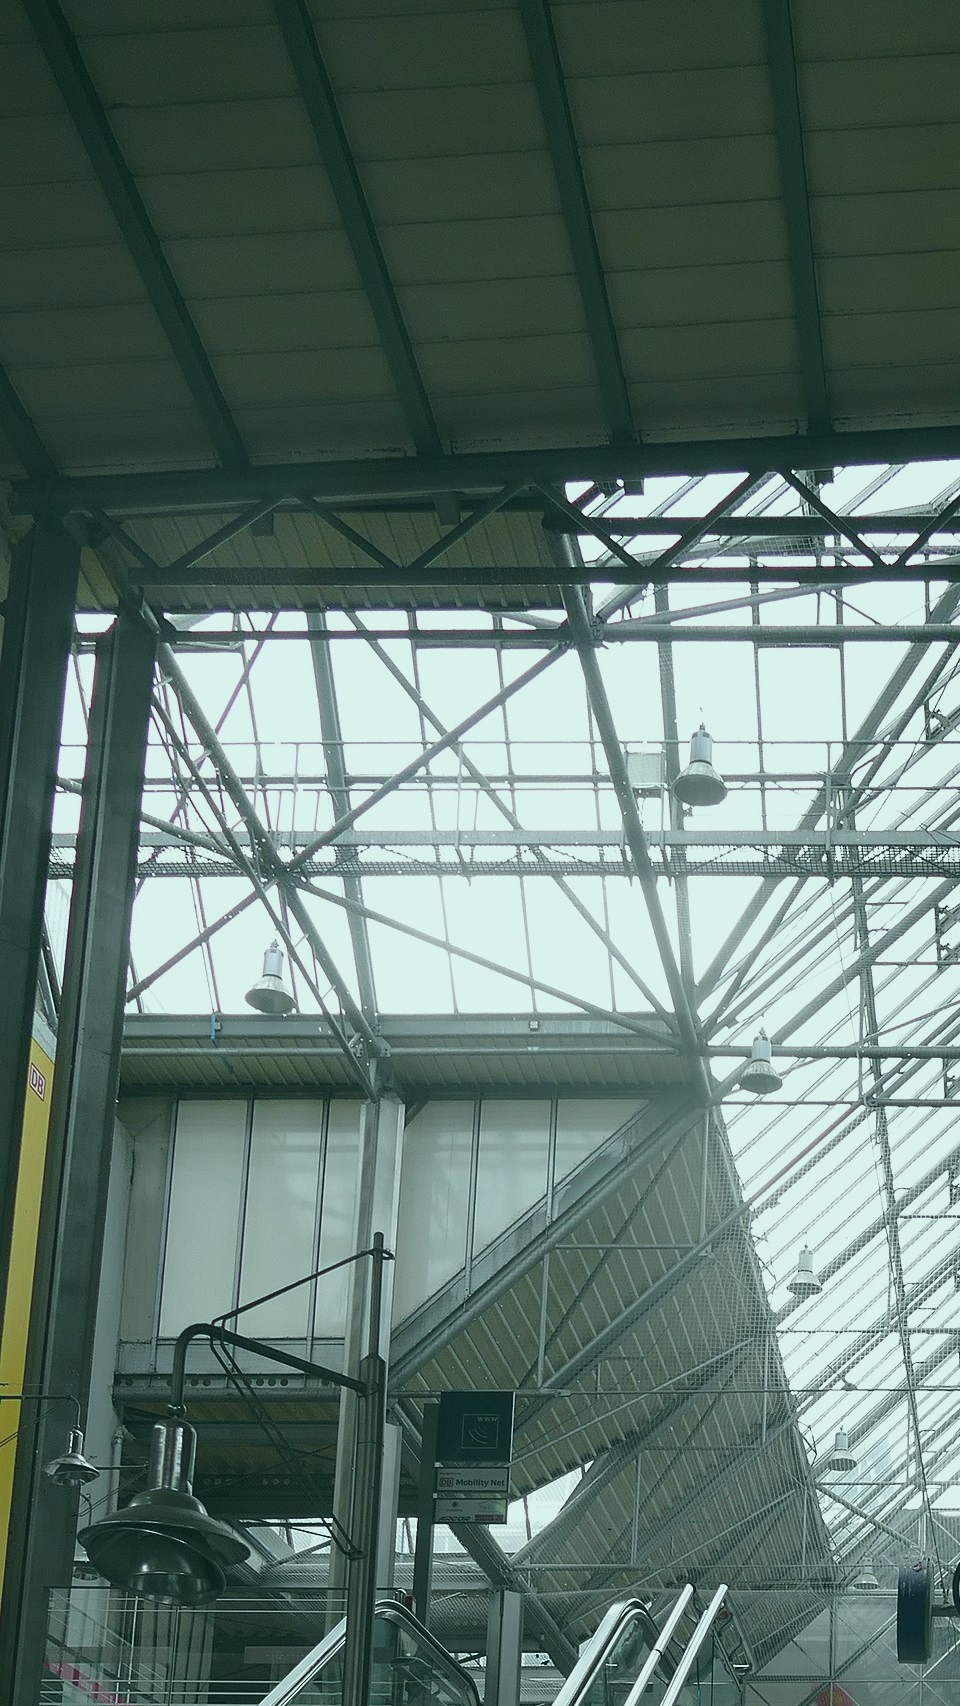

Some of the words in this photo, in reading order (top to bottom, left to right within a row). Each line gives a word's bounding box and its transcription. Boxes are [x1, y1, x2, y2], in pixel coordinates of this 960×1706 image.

[31, 1068, 44, 1096] DB
[441, 1479, 452, 1487] DB
[455, 1479, 489, 1488] Mobility
